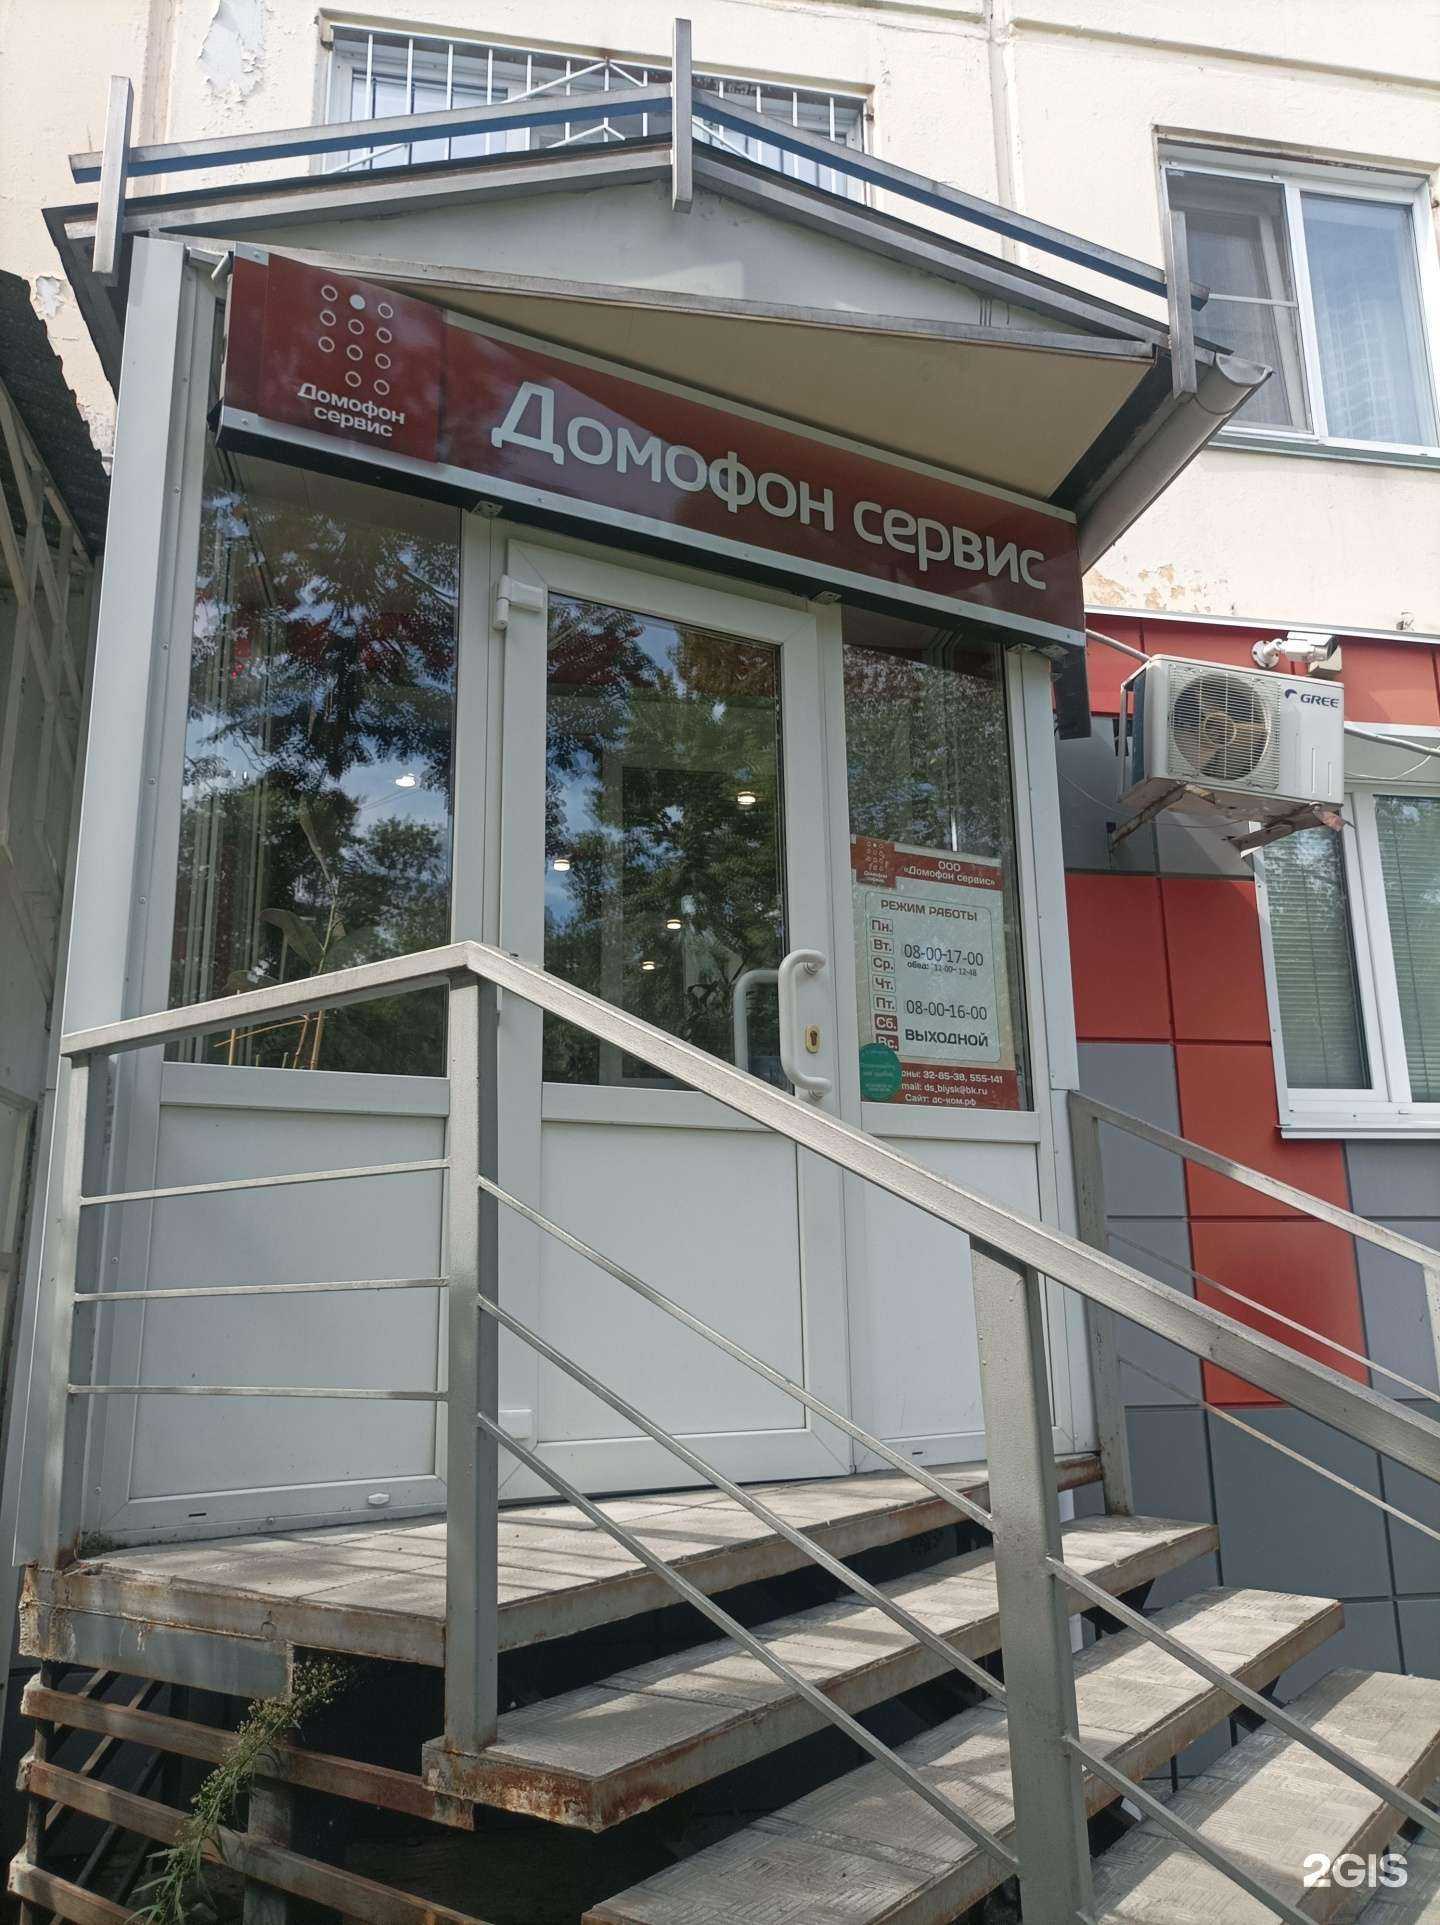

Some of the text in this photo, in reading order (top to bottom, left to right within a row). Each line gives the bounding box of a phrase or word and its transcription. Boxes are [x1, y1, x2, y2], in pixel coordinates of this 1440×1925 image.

[297, 382, 405, 425] Домофон
[314, 406, 393, 438] сервис
[491, 381, 1046, 590] Домофон сервис
[1300, 692, 1340, 708] GREE
[938, 861, 961, 871] ООО
[903, 865, 954, 880] «Домофон
[957, 874, 996, 886] сервис»
[880, 899, 977, 921] РЕЖИМ РАБОТЫ
[871, 919, 893, 933] Пн.
[873, 938, 893, 952] Вт.
[904, 944, 984, 966] 08-00-17-00
[873, 957, 894, 971] Ср.
[875, 977, 894, 990] Чт.
[876, 997, 895, 1010] Пт.
[906, 999, 988, 1020] 08-00-16-00
[876, 1016, 897, 1030] Сб.
[904, 1029, 989, 1047] ВЫХОДНОЙ
[969, 1073, 1003, 1084] 555-141
[905, 1093, 929, 1103] Сайт:
